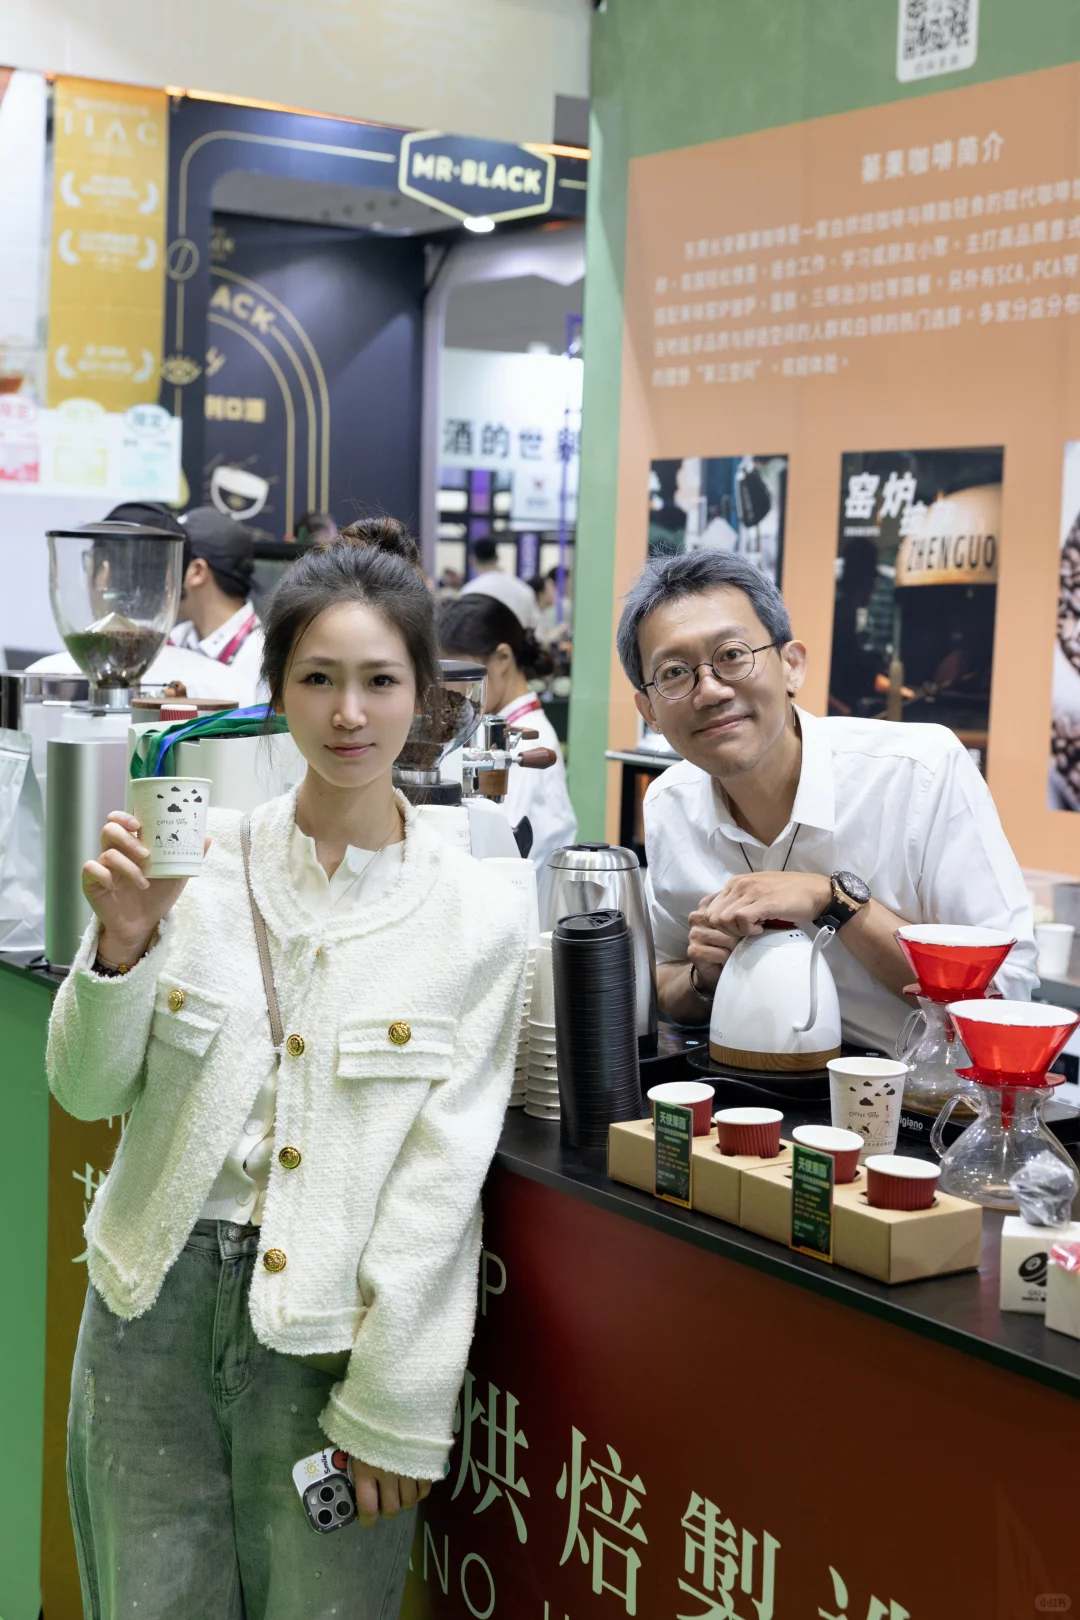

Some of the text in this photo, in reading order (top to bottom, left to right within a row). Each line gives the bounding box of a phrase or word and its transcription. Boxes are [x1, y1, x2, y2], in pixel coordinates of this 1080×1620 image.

[844, 471, 917, 518] 窑炉
[907, 535, 996, 572] ZHENGUO
[452, 1369, 911, 1620] 烘焙製
[410, 1520, 495, 1619] NO
